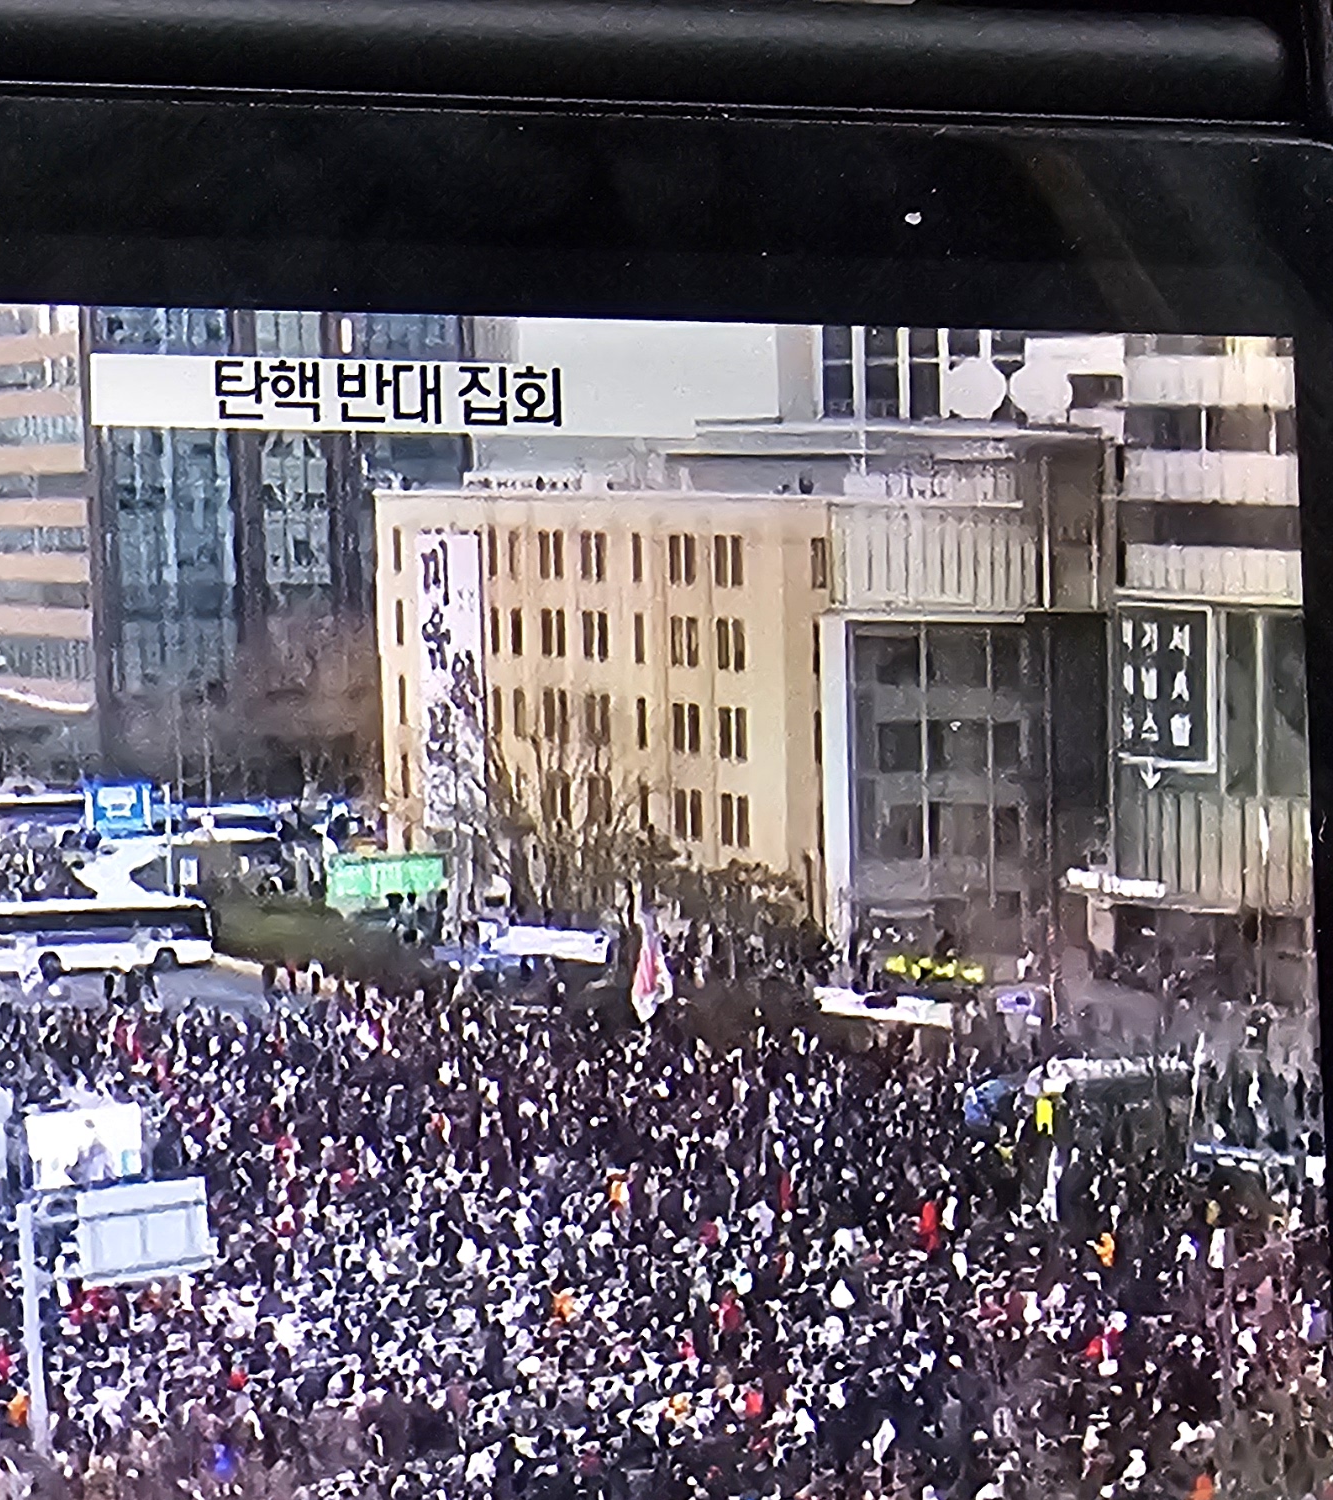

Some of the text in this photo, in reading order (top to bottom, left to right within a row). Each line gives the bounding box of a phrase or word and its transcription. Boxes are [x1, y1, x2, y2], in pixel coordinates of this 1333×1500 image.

[214, 360, 562, 427] 탄핵 반대 집회
